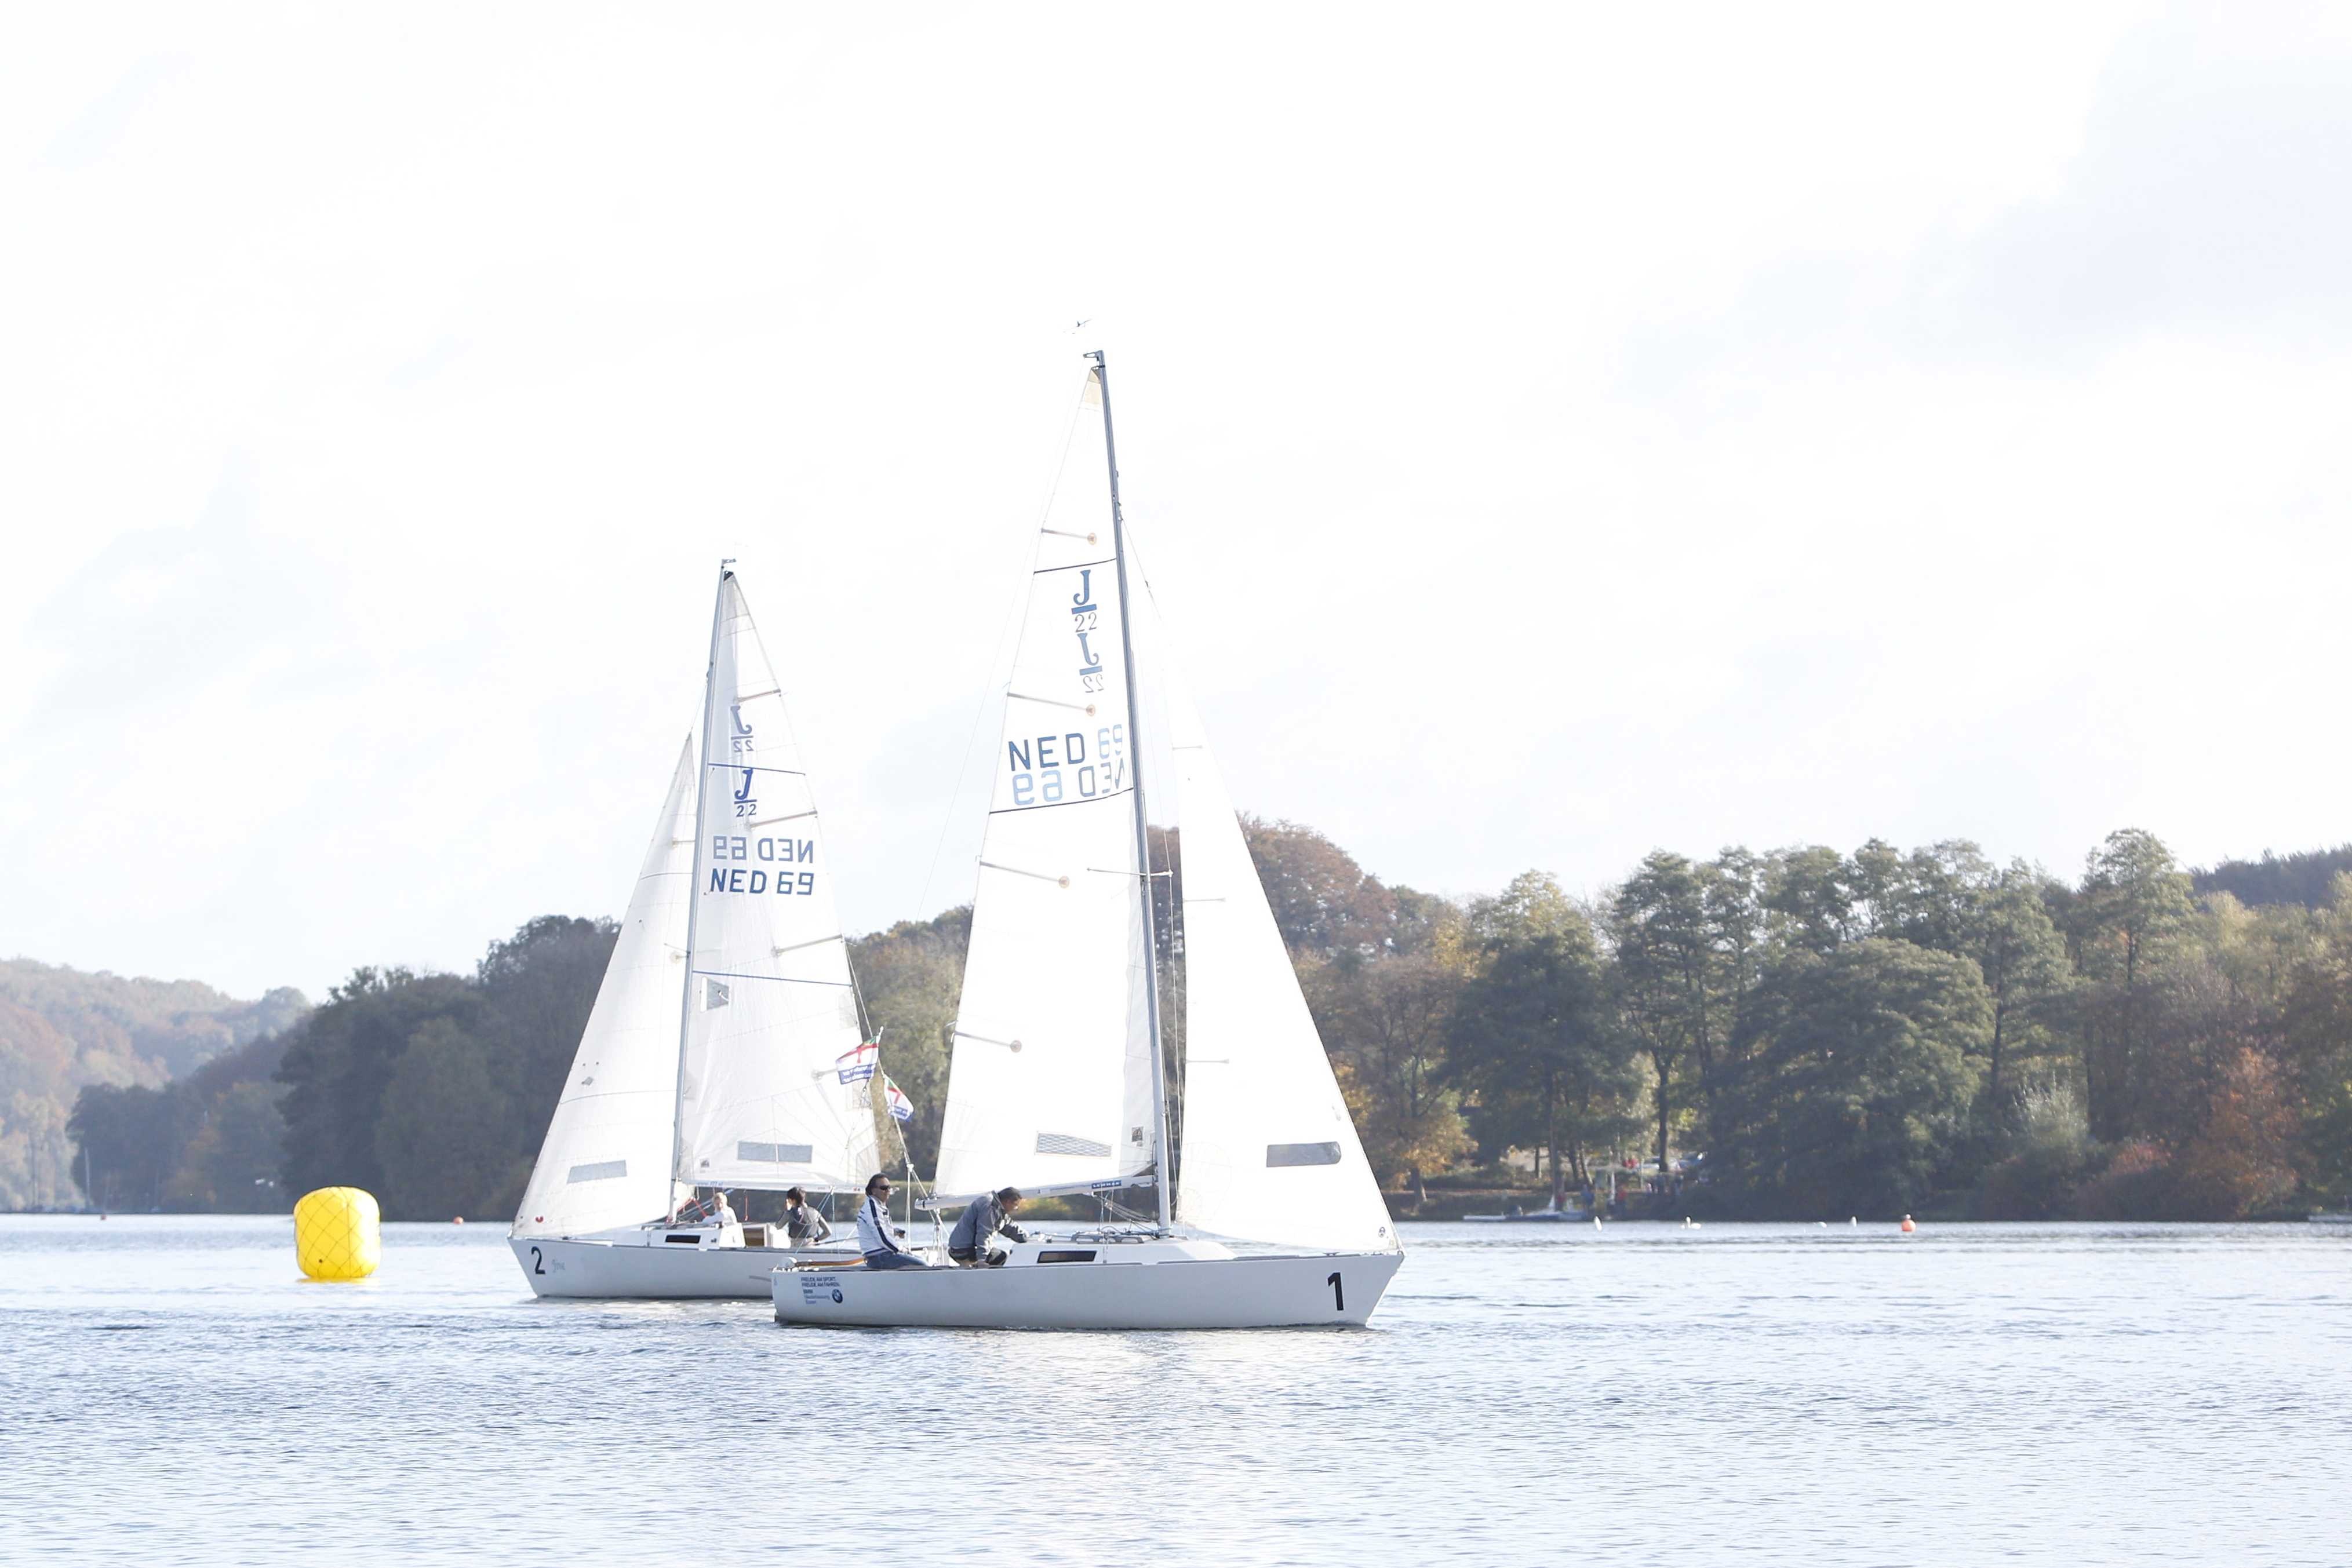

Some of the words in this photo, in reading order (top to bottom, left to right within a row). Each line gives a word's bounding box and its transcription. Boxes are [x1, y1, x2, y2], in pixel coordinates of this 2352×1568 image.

[1073, 570, 1091, 606] J
[1075, 612, 1098, 632] 22
[1008, 733, 1086, 771] NED
[1098, 724, 1123, 759] 69
[734, 768, 753, 800] J
[736, 804, 757, 818] 22
[711, 869, 767, 894] NED
[777, 871, 814, 895] 69
[531, 1246, 546, 1274] 2
[1327, 1272, 1344, 1311] 1
